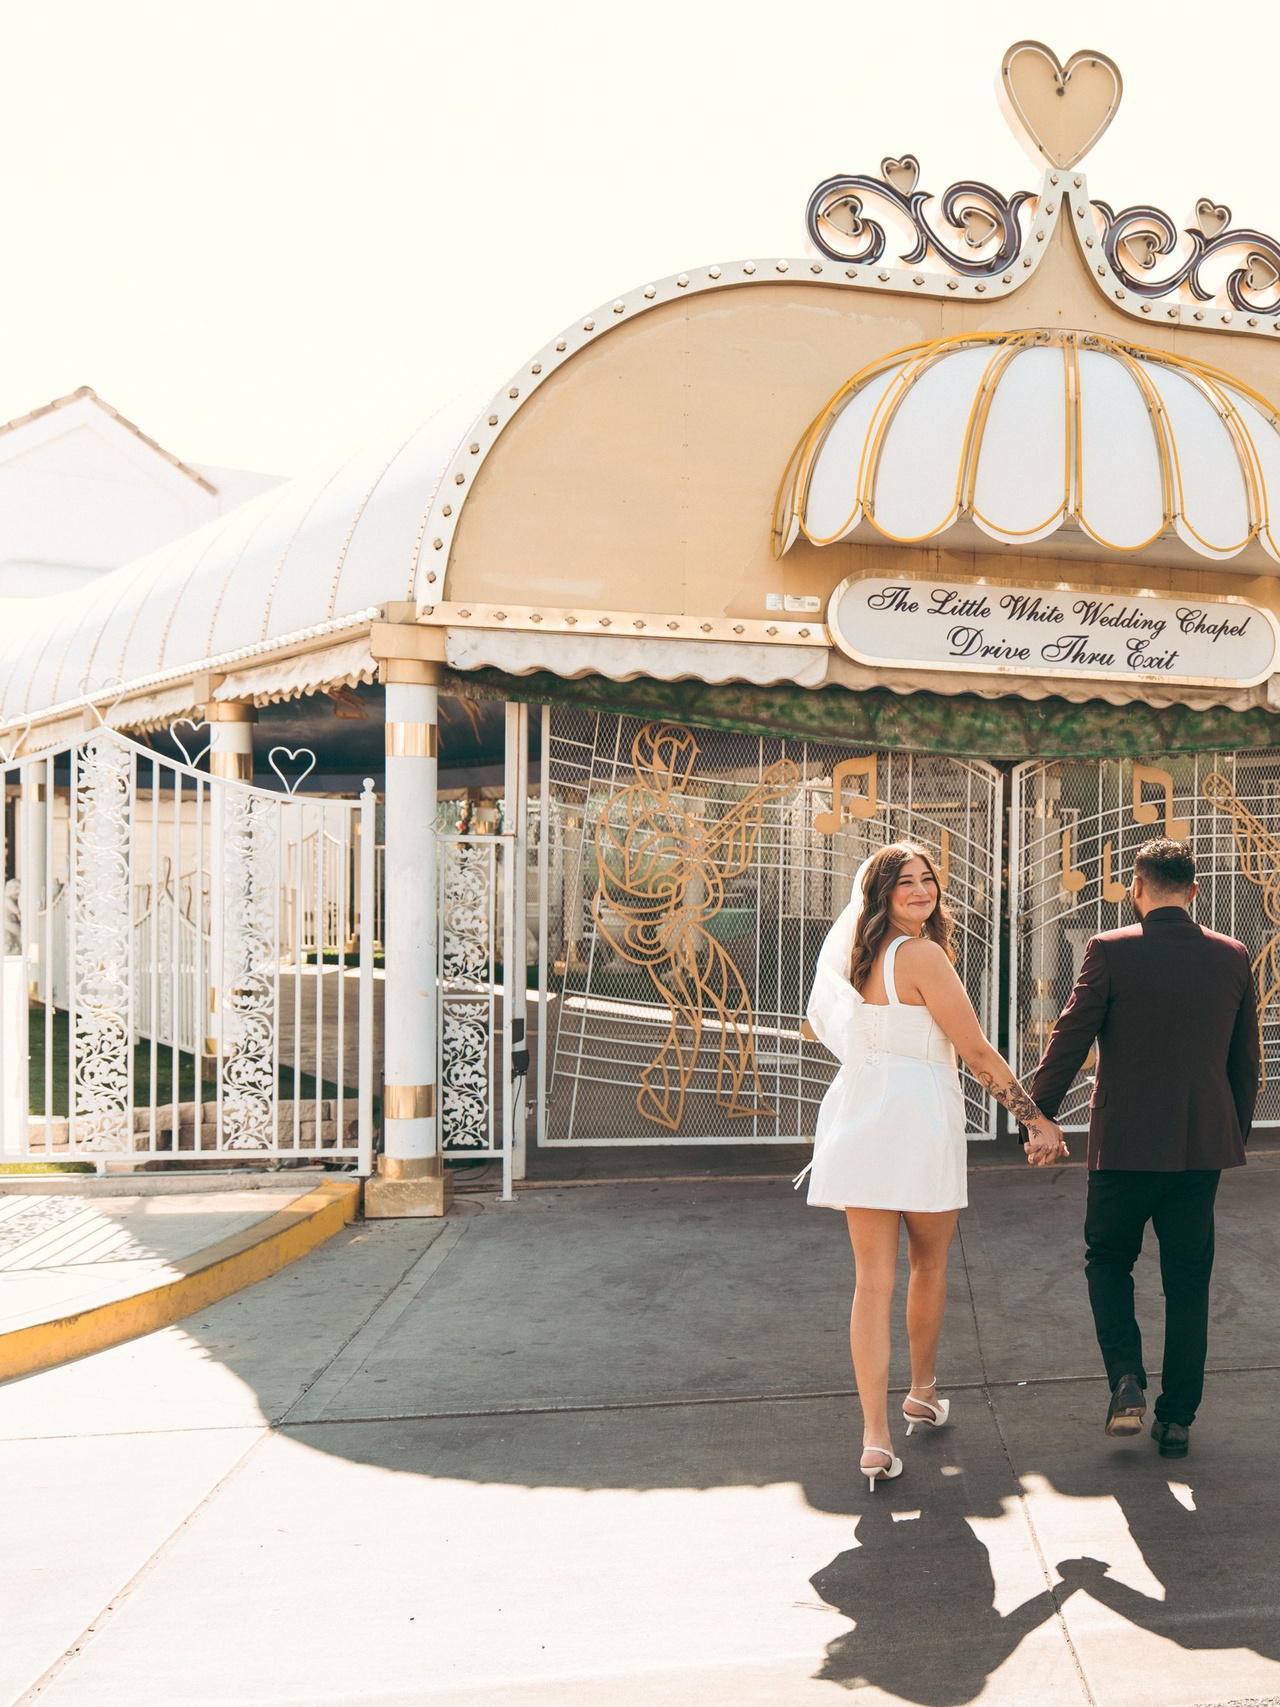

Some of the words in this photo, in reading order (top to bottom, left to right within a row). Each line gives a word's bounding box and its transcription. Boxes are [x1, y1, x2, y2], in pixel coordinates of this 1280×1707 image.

[867, 586, 919, 613] The
[927, 588, 991, 618] Little
[1000, 594, 1065, 625] White
[1073, 600, 1168, 640] Wedding
[1175, 608, 1252, 642] Chapel
[946, 625, 1031, 661] Drive
[1040, 635, 1116, 666] Thru
[1126, 637, 1180, 671] Exit
